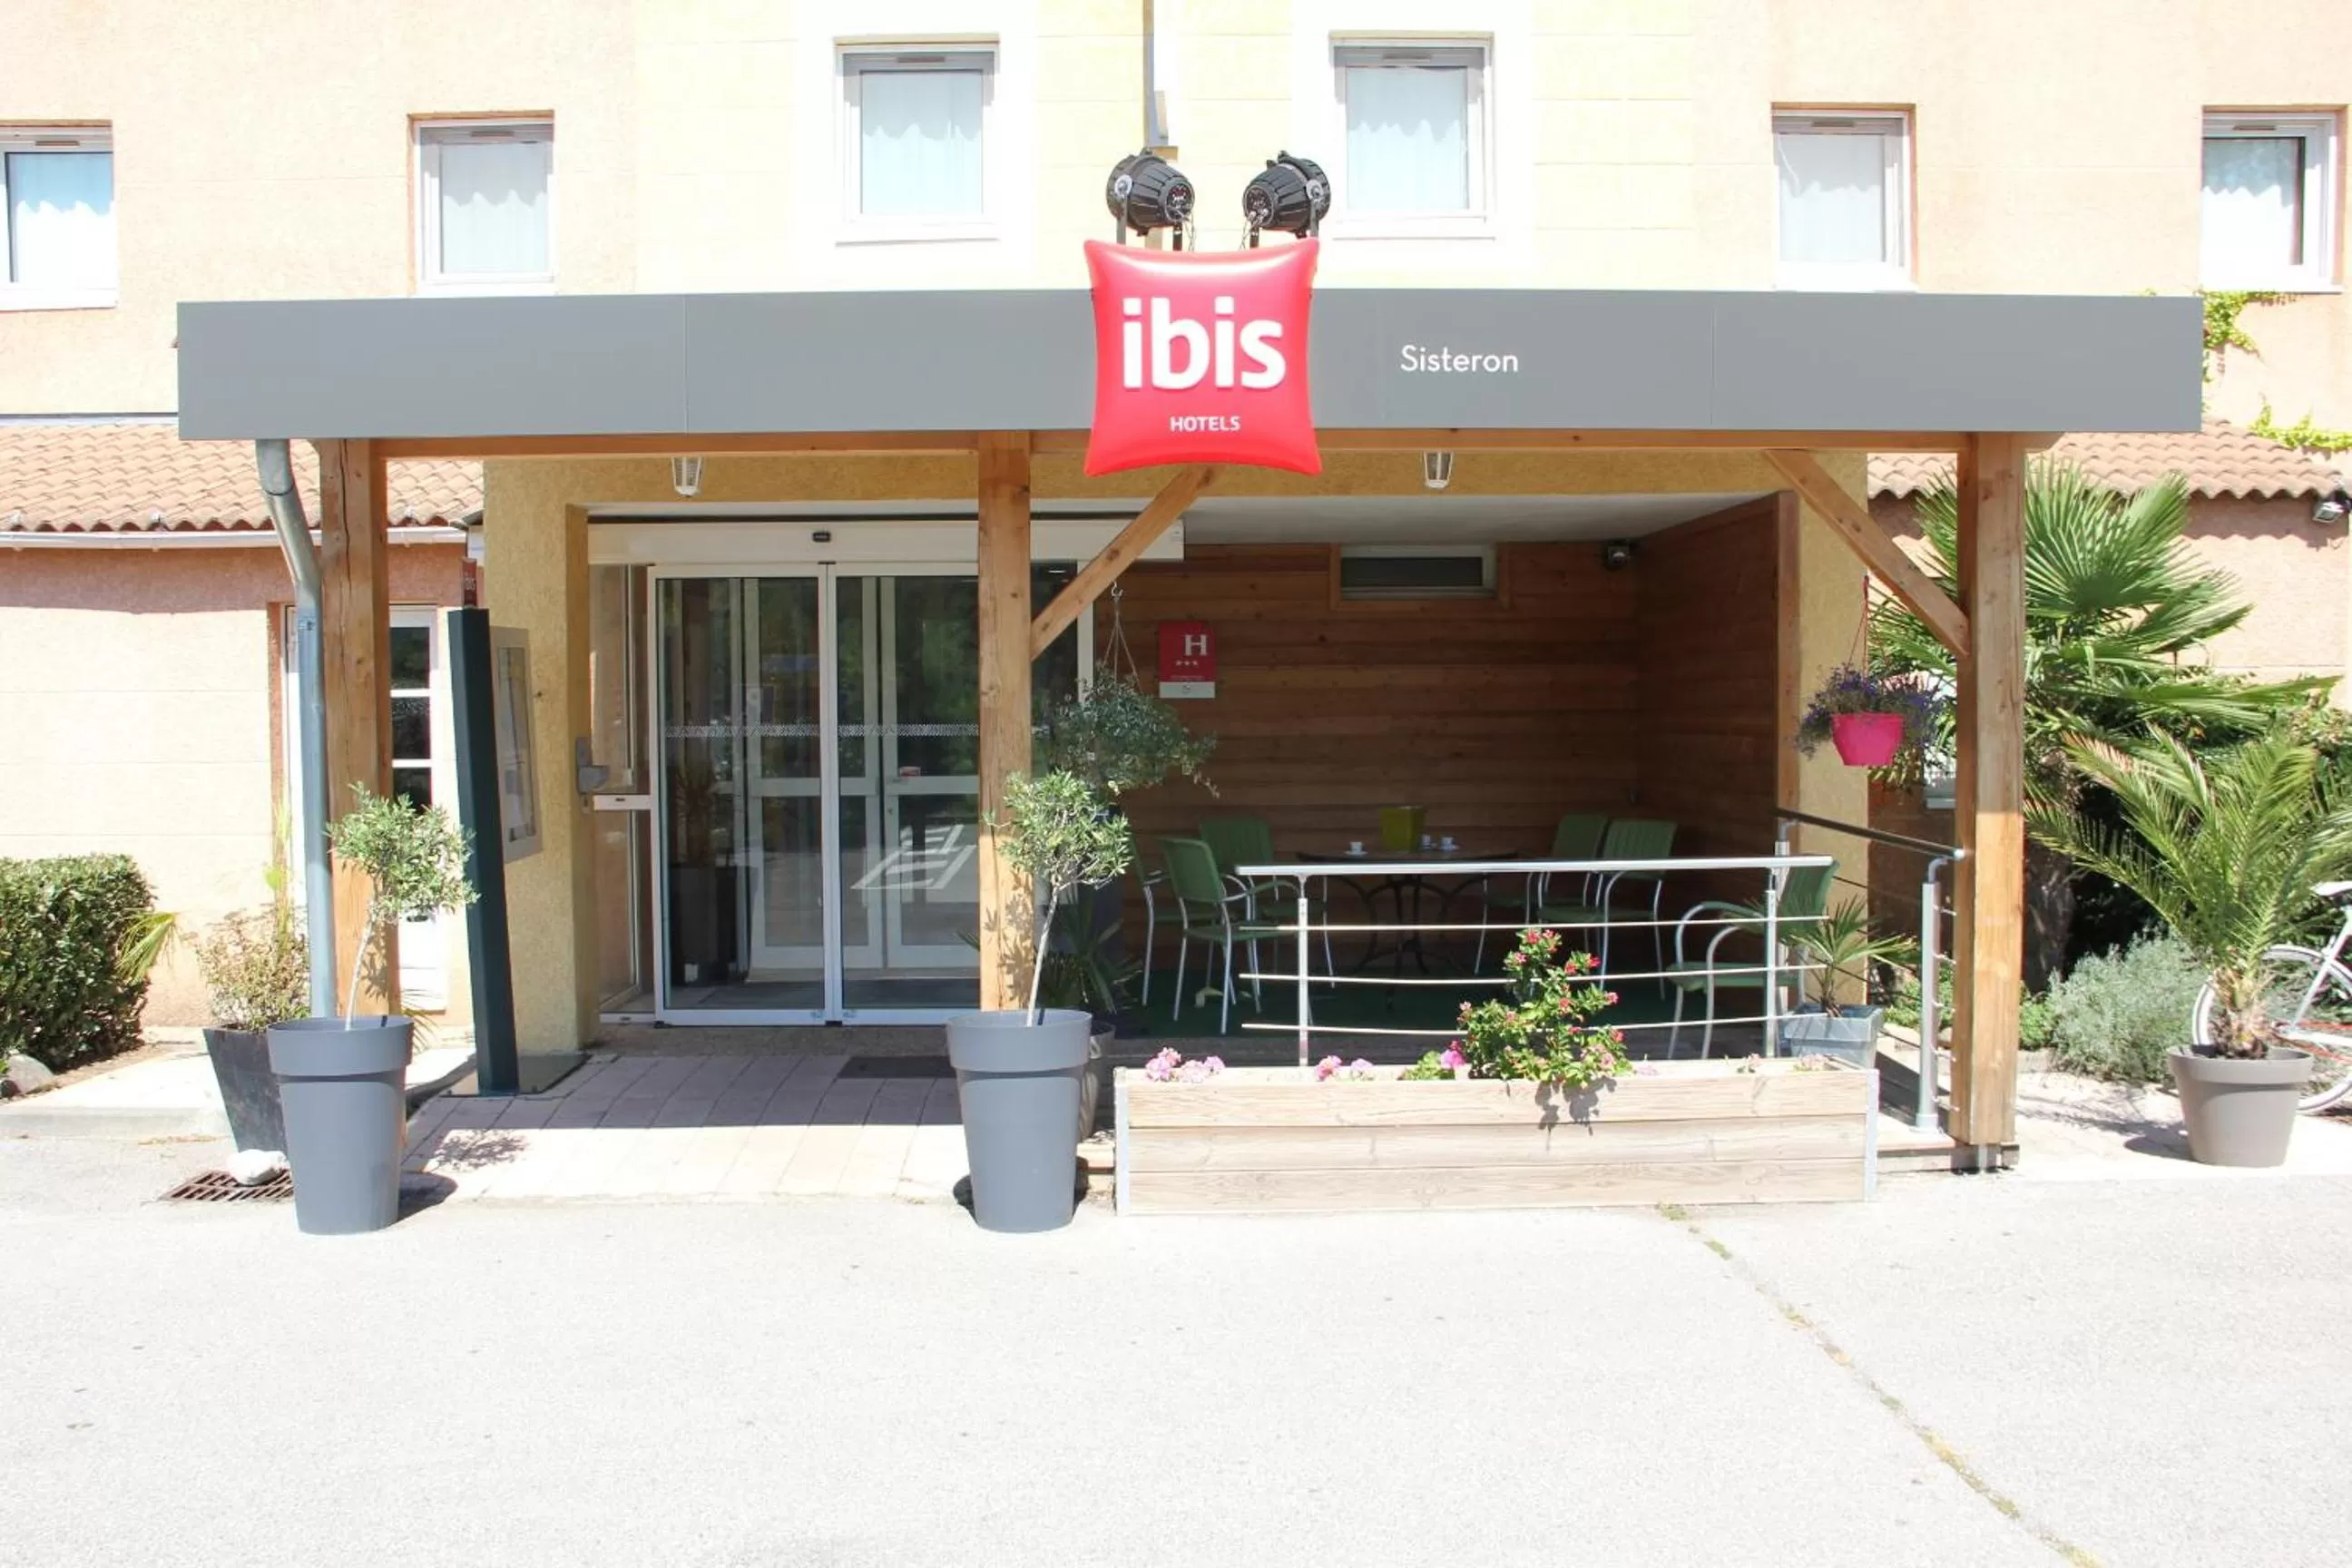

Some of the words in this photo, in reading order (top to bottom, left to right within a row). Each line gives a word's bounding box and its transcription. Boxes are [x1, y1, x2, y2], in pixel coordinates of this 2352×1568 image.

[1122, 296, 1286, 389] ibis
[1400, 345, 1518, 372] Sisteron
[1170, 416, 1240, 431] HOTELS
[1183, 633, 1209, 656] H
